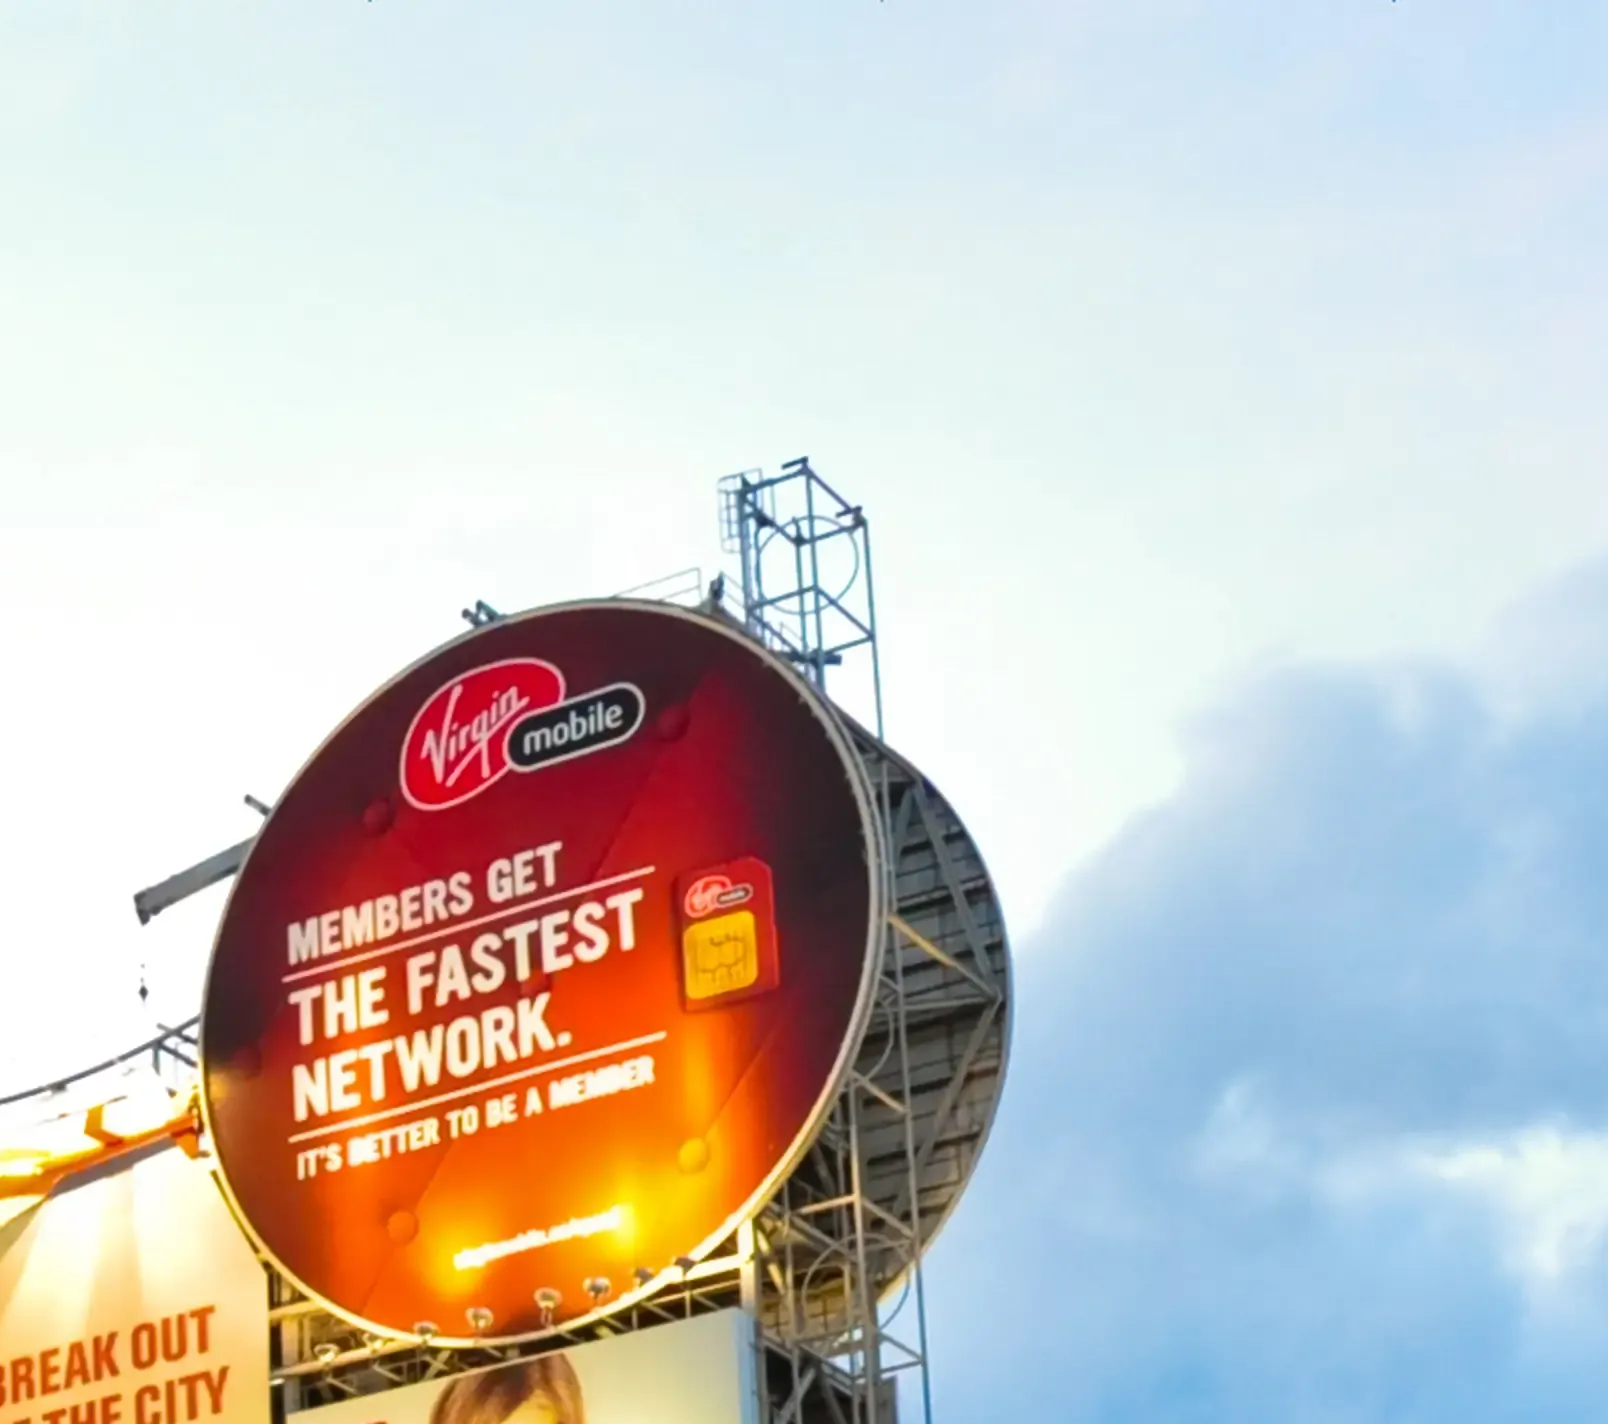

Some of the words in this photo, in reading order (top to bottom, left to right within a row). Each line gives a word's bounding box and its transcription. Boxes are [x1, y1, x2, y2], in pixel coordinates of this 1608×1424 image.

[420, 684, 530, 787] Virgin
[523, 701, 623, 756] mobile
[286, 866, 473, 964] MEMBERS
[485, 841, 563, 902] GET
[288, 966, 390, 1046] THE
[406, 888, 645, 1011] FASTEST
[292, 993, 573, 1121] NETWORK.
[297, 1143, 344, 1181] IT'S
[347, 1117, 441, 1168] BETTER
[444, 1106, 480, 1140] TO
[485, 1093, 519, 1129] BE
[524, 1086, 544, 1117] A
[547, 1055, 657, 1110] MEMBER
[130, 1305, 216, 1373] OUT
